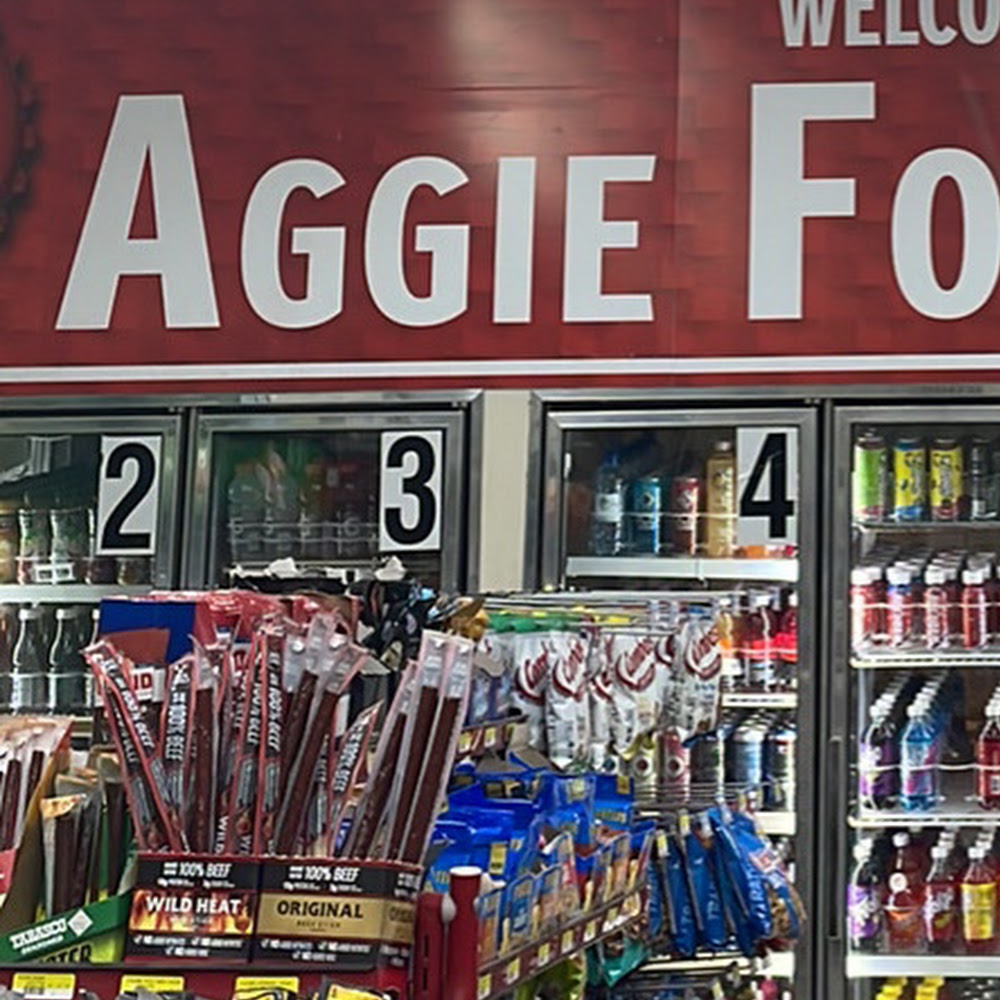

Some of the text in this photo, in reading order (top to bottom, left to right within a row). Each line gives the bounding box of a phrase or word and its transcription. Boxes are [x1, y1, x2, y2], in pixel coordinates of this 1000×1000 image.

[54, 93, 656, 331] AGGIE
[99, 443, 155, 550] 2
[383, 437, 436, 544] 3
[739, 432, 794, 538] 4
[145, 896, 242, 915] WILD HEAT
[277, 900, 363, 919] ORIGINAL
